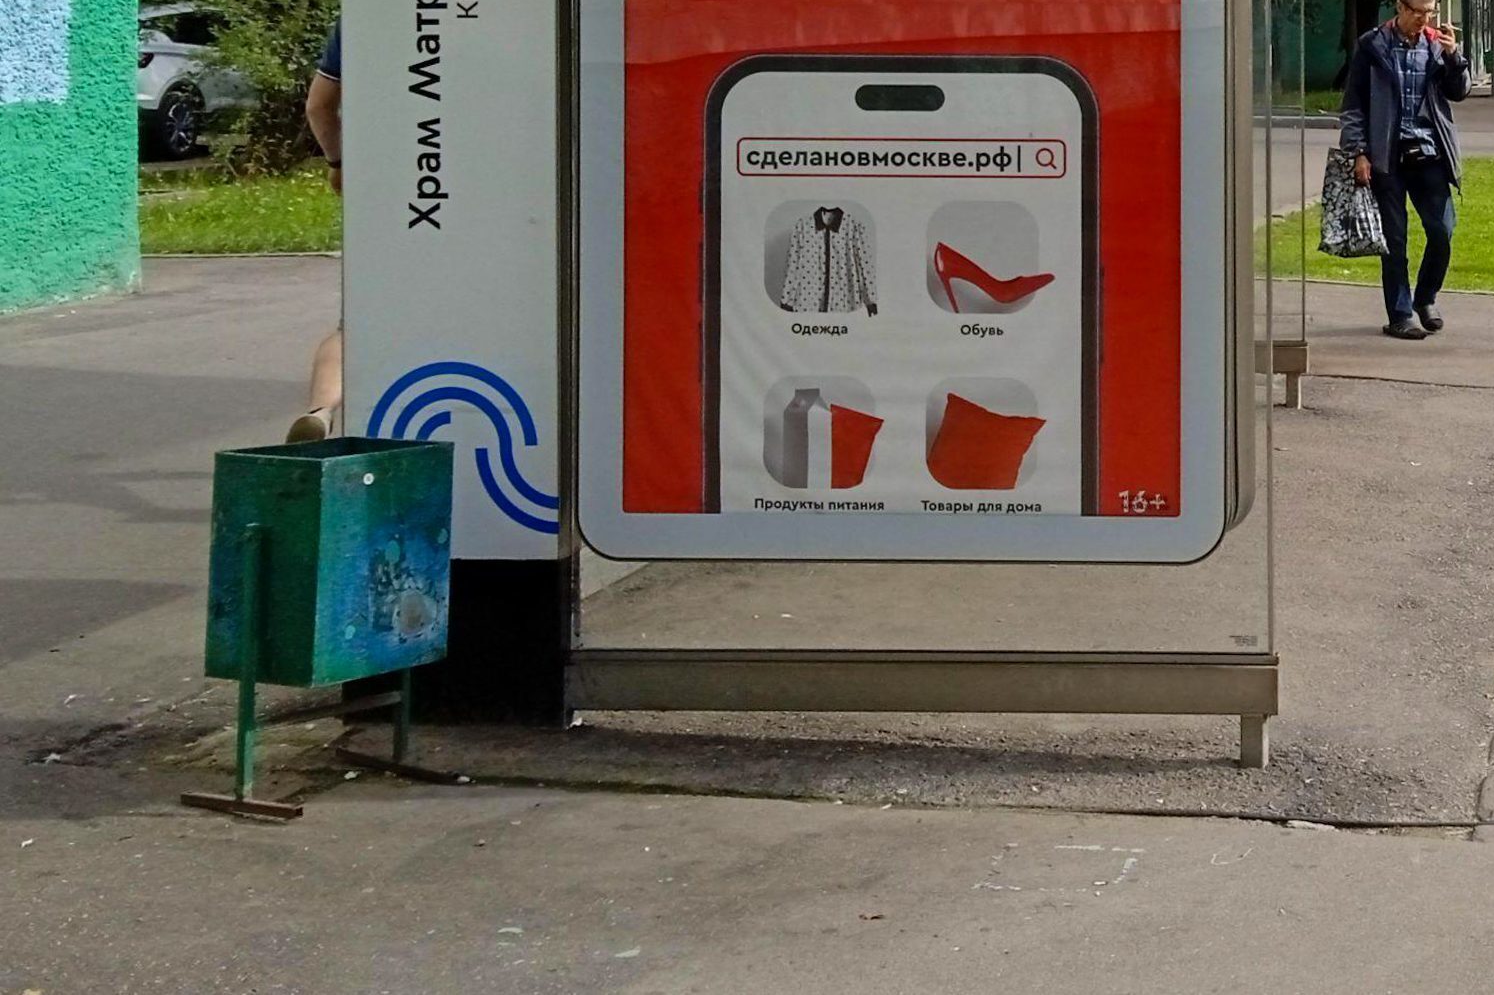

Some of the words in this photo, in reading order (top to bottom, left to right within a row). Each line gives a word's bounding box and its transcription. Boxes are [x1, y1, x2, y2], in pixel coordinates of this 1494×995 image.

[745, 145, 1013, 172] сделановмоскве.рф
[408, 117, 449, 230] Храм
[790, 322, 849, 336] Одежда
[959, 323, 1005, 338] Обувь
[753, 497, 825, 512] Продукты
[827, 499, 885, 512] питания
[920, 499, 974, 514] Товары
[976, 501, 1002, 514] для
[1005, 501, 1042, 514] дома
